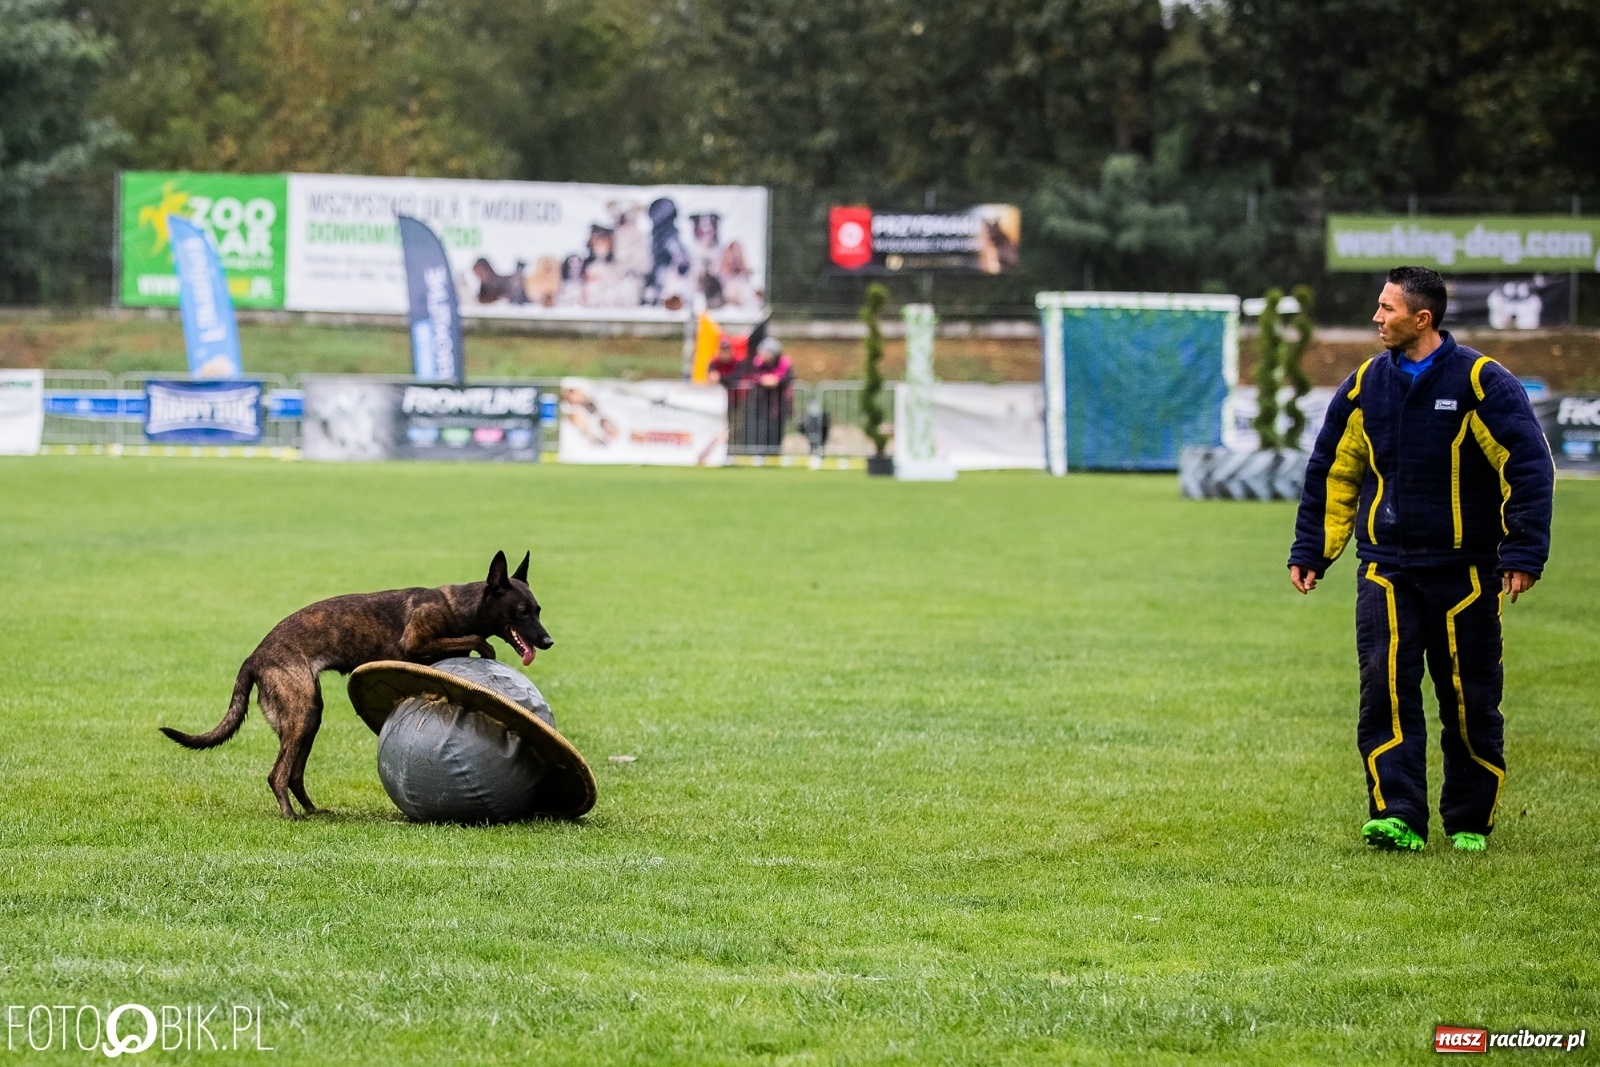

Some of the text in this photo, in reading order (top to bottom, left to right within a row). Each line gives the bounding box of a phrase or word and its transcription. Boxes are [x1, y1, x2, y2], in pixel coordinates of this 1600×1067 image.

[187, 196, 277, 231] ZOO
[1334, 224, 1593, 266] working-dog.com
[402, 386, 538, 415] FRONTLINE
